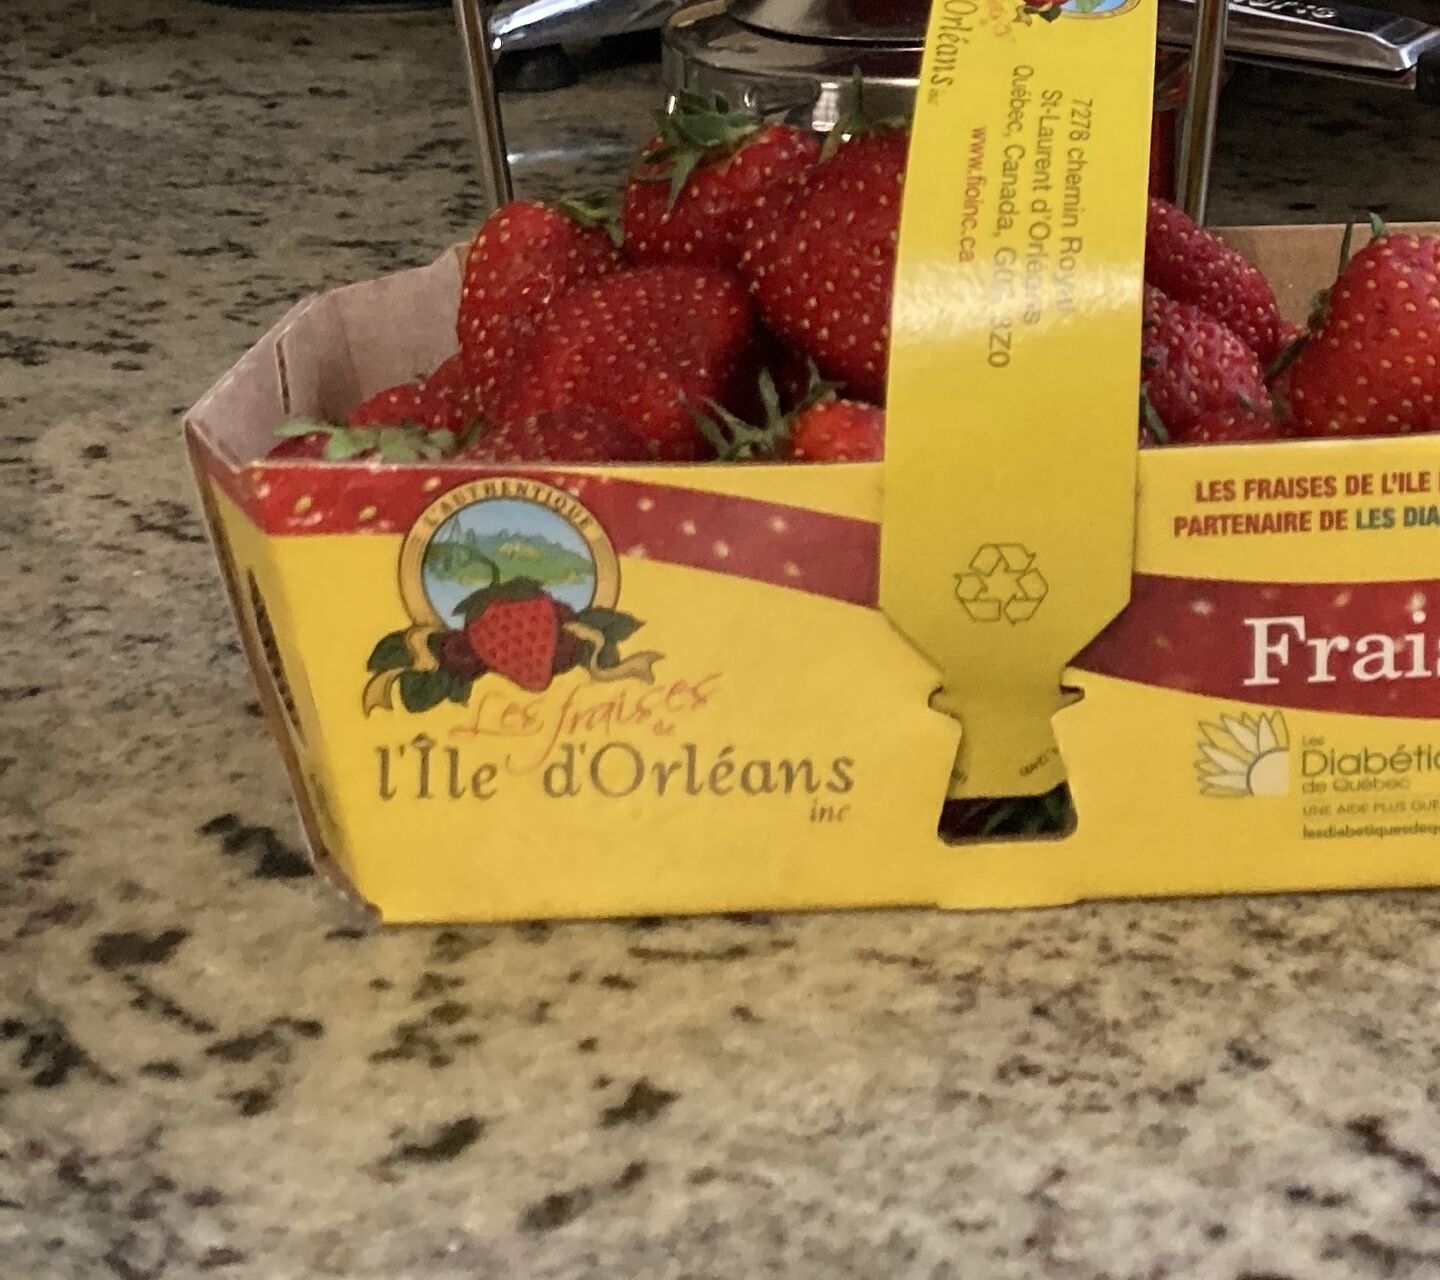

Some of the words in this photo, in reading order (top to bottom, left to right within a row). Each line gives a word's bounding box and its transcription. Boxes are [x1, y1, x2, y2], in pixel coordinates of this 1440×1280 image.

[1002, 64, 1035, 138] Québec,
[1068, 98, 1095, 142] 7278
[1032, 88, 1064, 192] St-Laurent
[957, 125, 988, 265] www.fioinc.ca
[992, 143, 1027, 238] Canada,
[1060, 146, 1089, 228] chemin
[1194, 478, 1237, 503] LES
[1242, 474, 1338, 502] FRAISES
[1344, 472, 1375, 497] DE
[1381, 470, 1433, 496] L'ILE
[1172, 509, 1313, 538] PARTENAIRE
[1319, 508, 1349, 533] DE
[1355, 506, 1396, 531] LES
[543, 741, 857, 799] d'Orléans
[808, 798, 851, 824] inc
